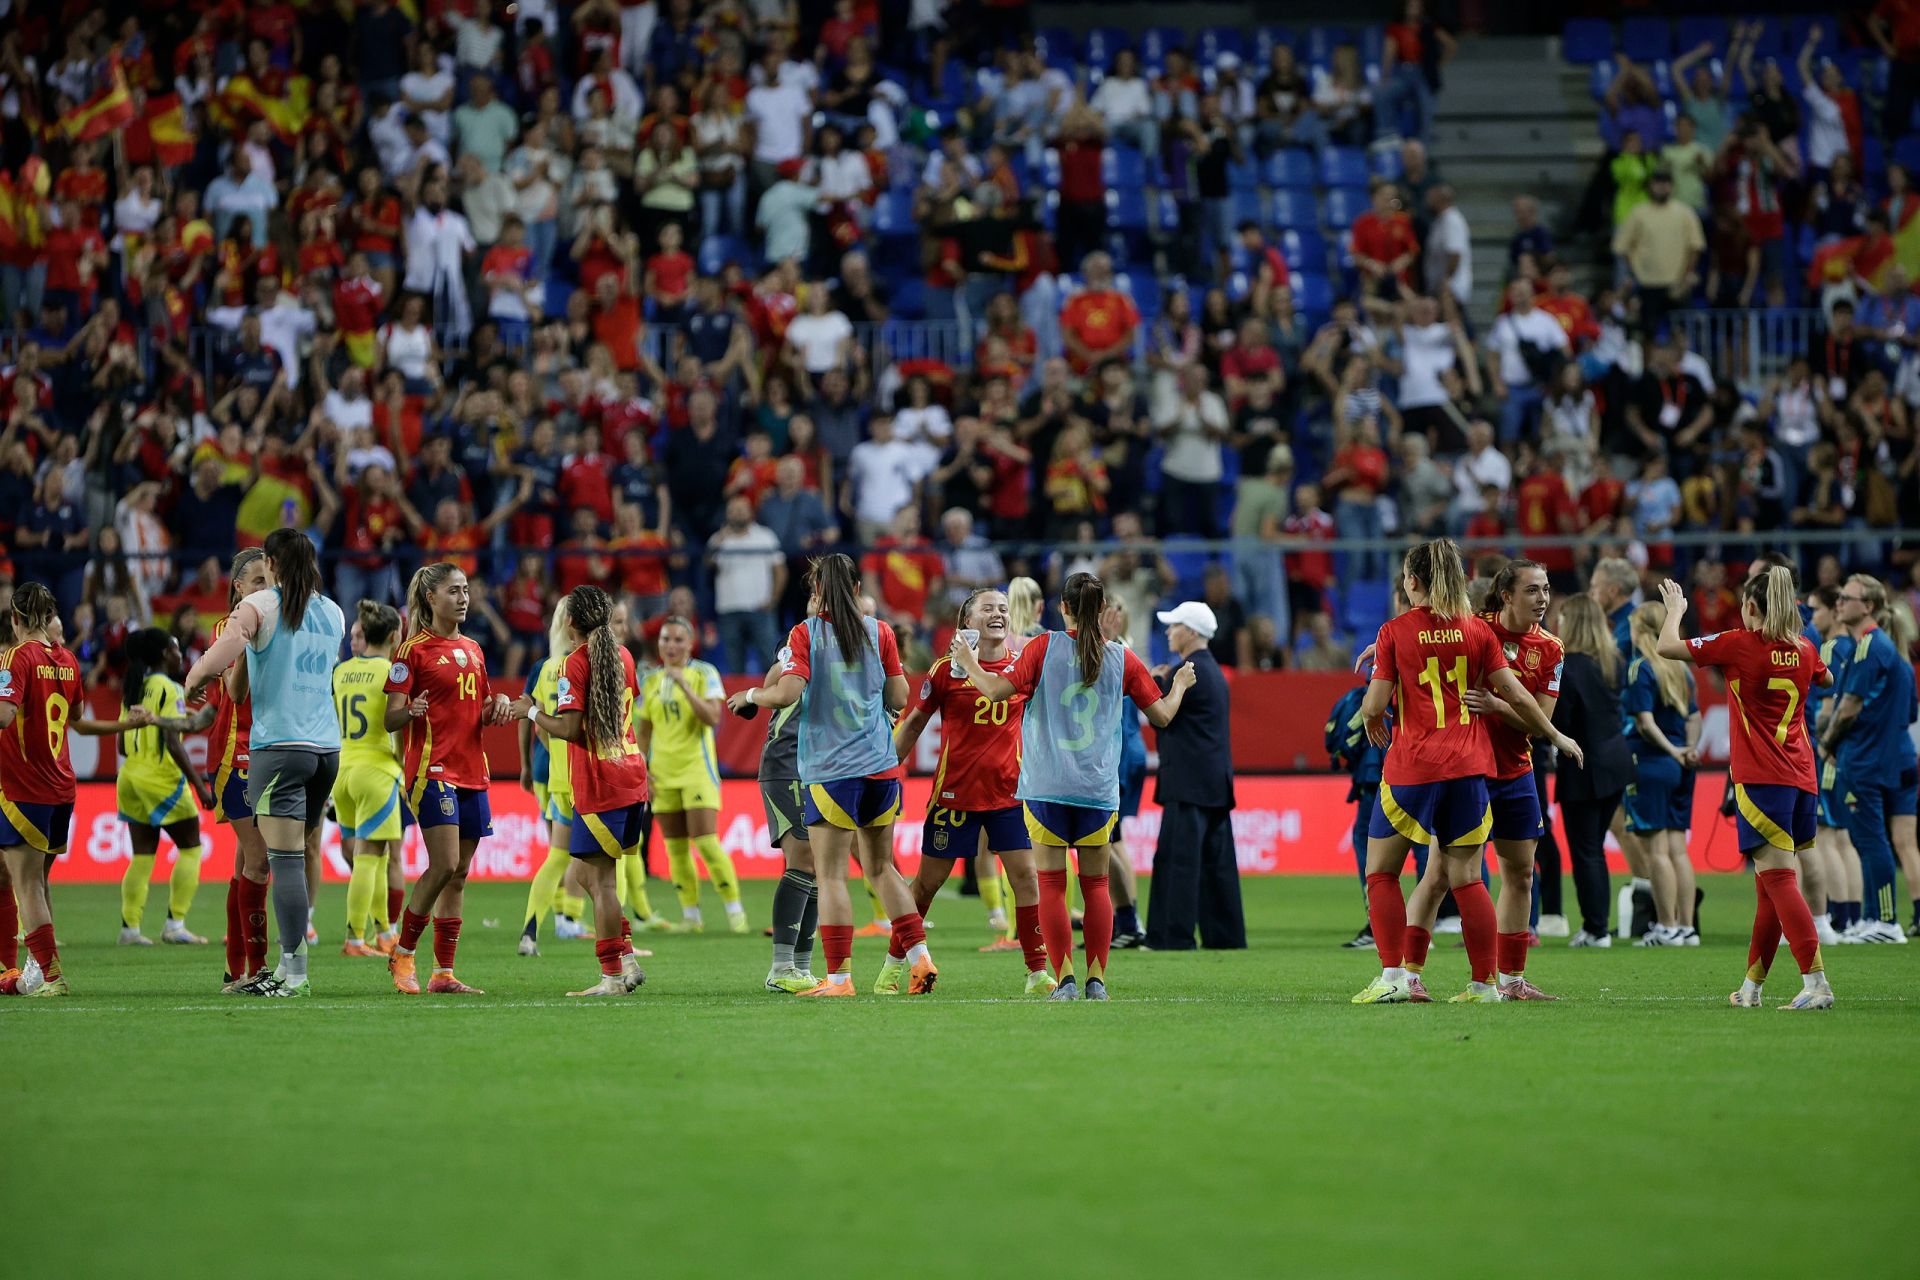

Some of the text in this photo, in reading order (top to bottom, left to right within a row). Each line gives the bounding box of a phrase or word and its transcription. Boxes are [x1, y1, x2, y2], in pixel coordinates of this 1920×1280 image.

[1418, 629, 1464, 645] ALEXIA
[36, 664, 74, 681] MARIONA
[1771, 650, 1800, 667] OLGA
[456, 672, 477, 701] 14
[830, 662, 866, 732] 5
[1418, 655, 1471, 729] 11
[45, 692, 69, 760] 8
[341, 693, 368, 740] 15
[974, 695, 1009, 726] 20
[1057, 682, 1099, 752] 3
[1767, 678, 1800, 746] 7
[933, 804, 967, 828] 20
